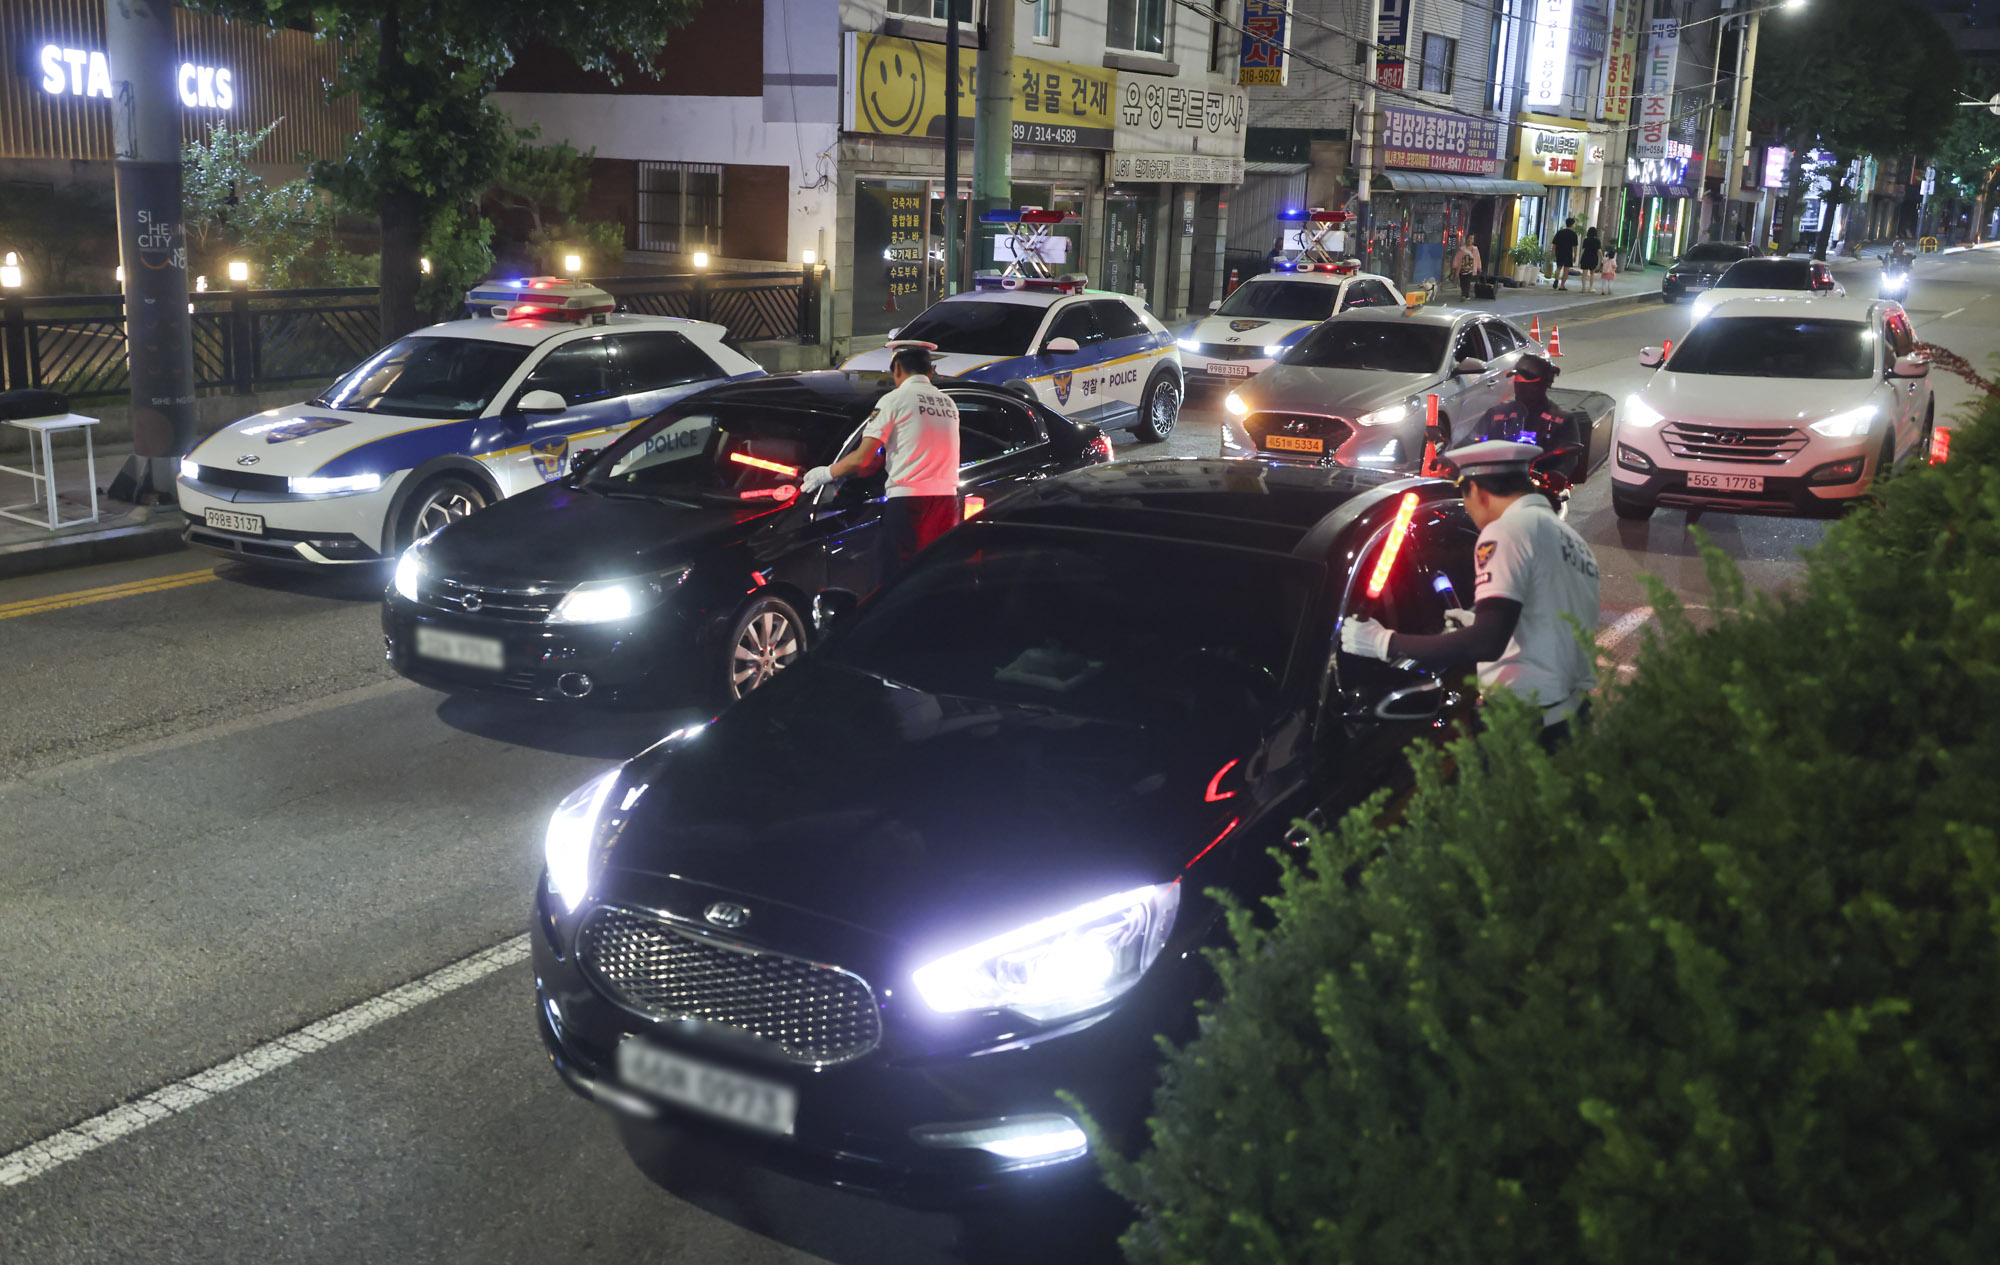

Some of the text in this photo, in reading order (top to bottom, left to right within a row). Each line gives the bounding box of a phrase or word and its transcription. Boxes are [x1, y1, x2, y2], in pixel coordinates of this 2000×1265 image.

[1652, 24, 1680, 39] 대명
[1245, 17, 1280, 66] 공사
[1239, 69, 1281, 83] 318-9627
[1604, 26, 1622, 112] 부동산
[1617, 53, 1631, 115] 전문
[1022, 68, 1061, 113] 철물
[1071, 77, 1109, 116] 건재
[1123, 82, 1243, 133] 유영닥트공사
[1012, 125, 1077, 144] 89 314-4589
[1637, 145, 1664, 154] 311-0584
[892, 197, 919, 209] 건축자재
[138, 210, 152, 223] SI
[892, 214, 919, 227] 종합철물
[138, 235, 172, 248] CITY
[891, 249, 919, 262] 전기재료
[890, 266, 918, 279] 수도부속
[890, 283, 918, 295] 각종호스
[1228, 366, 1245, 375] 3152
[1082, 369, 1137, 396] 경찰 POLICE
[919, 405, 958, 420] POLICE
[645, 429, 698, 455] POLICE
[1294, 438, 1319, 450] 5334
[544, 470, 562, 481] POLICE
[1694, 474, 1757, 489] 55오 1778
[233, 515, 259, 531] 3137
